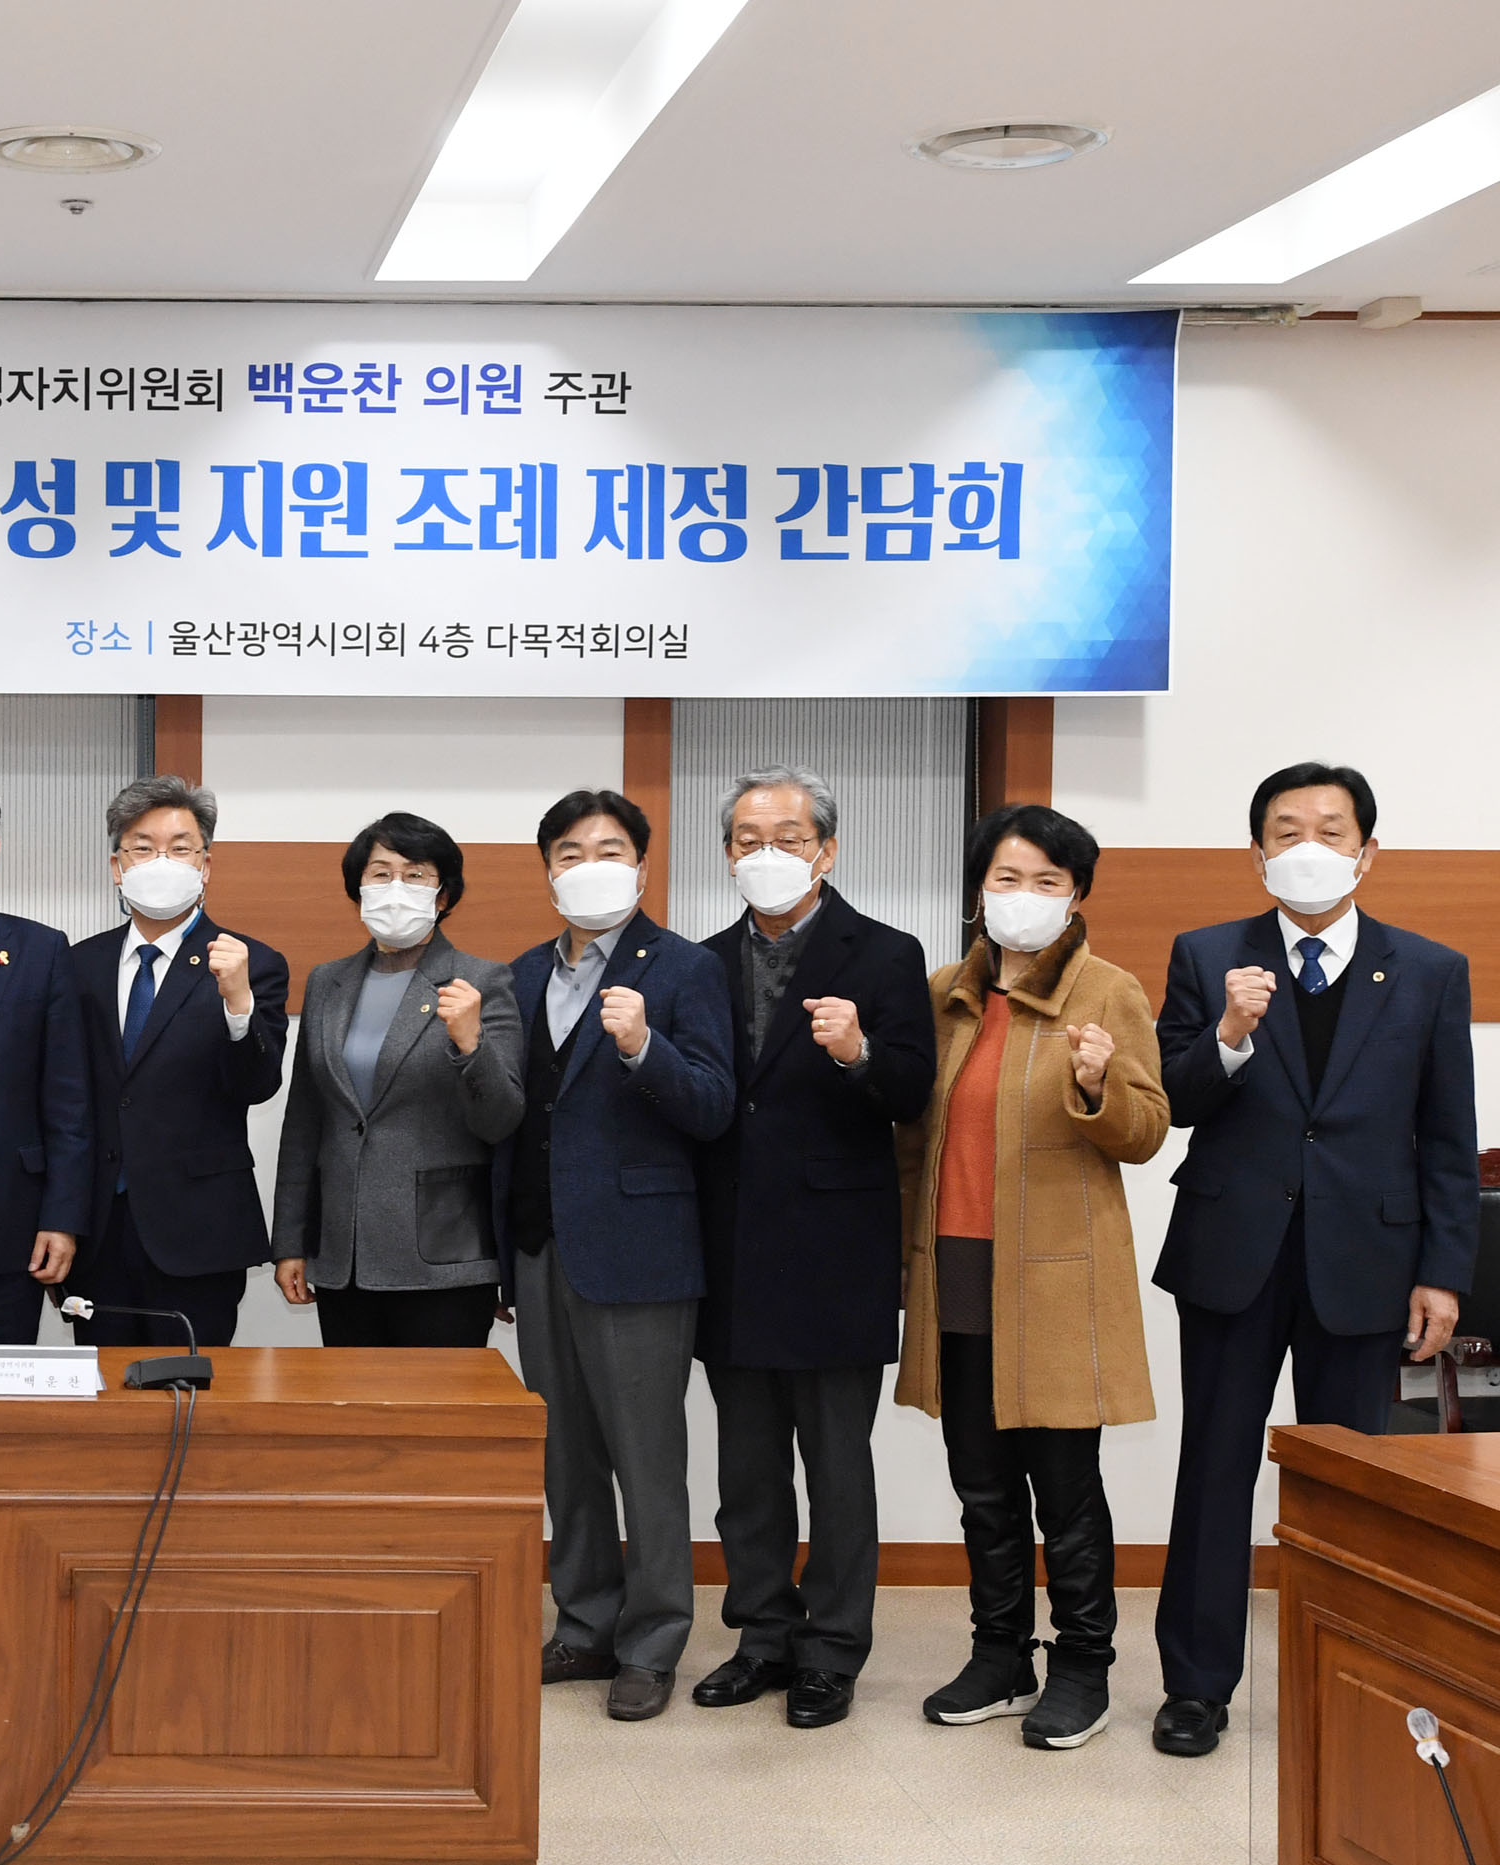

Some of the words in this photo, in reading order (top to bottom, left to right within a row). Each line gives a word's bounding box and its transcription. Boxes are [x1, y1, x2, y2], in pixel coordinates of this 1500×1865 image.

[247, 361, 403, 415] 백운찬
[422, 362, 523, 416] 의원
[543, 370, 633, 416] 주관
[105, 457, 183, 558] 및
[206, 460, 370, 559] 지원
[394, 461, 559, 560] 조례
[584, 462, 749, 563] 제정
[774, 460, 1025, 562] 간담회
[66, 619, 133, 657] 장소
[167, 619, 406, 659] 울산광역시의회
[417, 621, 475, 660] 4층
[486, 622, 689, 660] 다목적회의실
